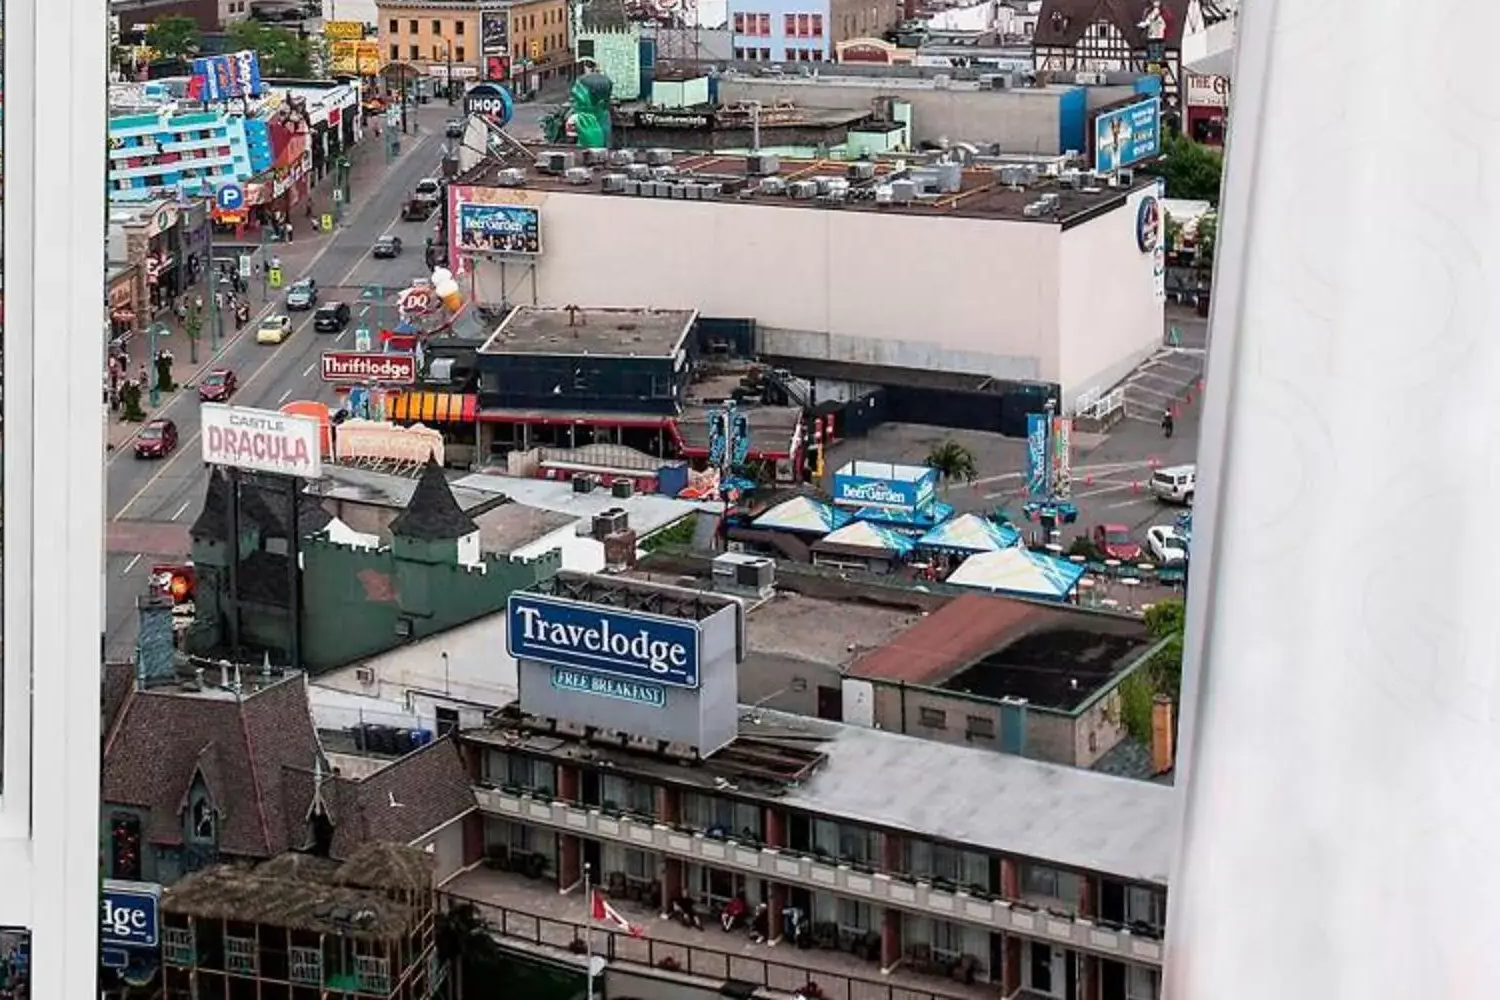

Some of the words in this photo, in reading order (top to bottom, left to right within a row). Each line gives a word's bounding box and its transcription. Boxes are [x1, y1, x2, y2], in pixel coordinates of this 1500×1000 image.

[469, 99, 501, 114] IHOP
[223, 189, 238, 205] P
[406, 294, 429, 310] DQ
[323, 356, 411, 380] Thriftlodge
[229, 414, 285, 432] CASTLE
[207, 424, 311, 467] DRACULA
[516, 605, 688, 674] Travelodge
[557, 671, 590, 688] FREE
[591, 677, 663, 703] BREAKFAST
